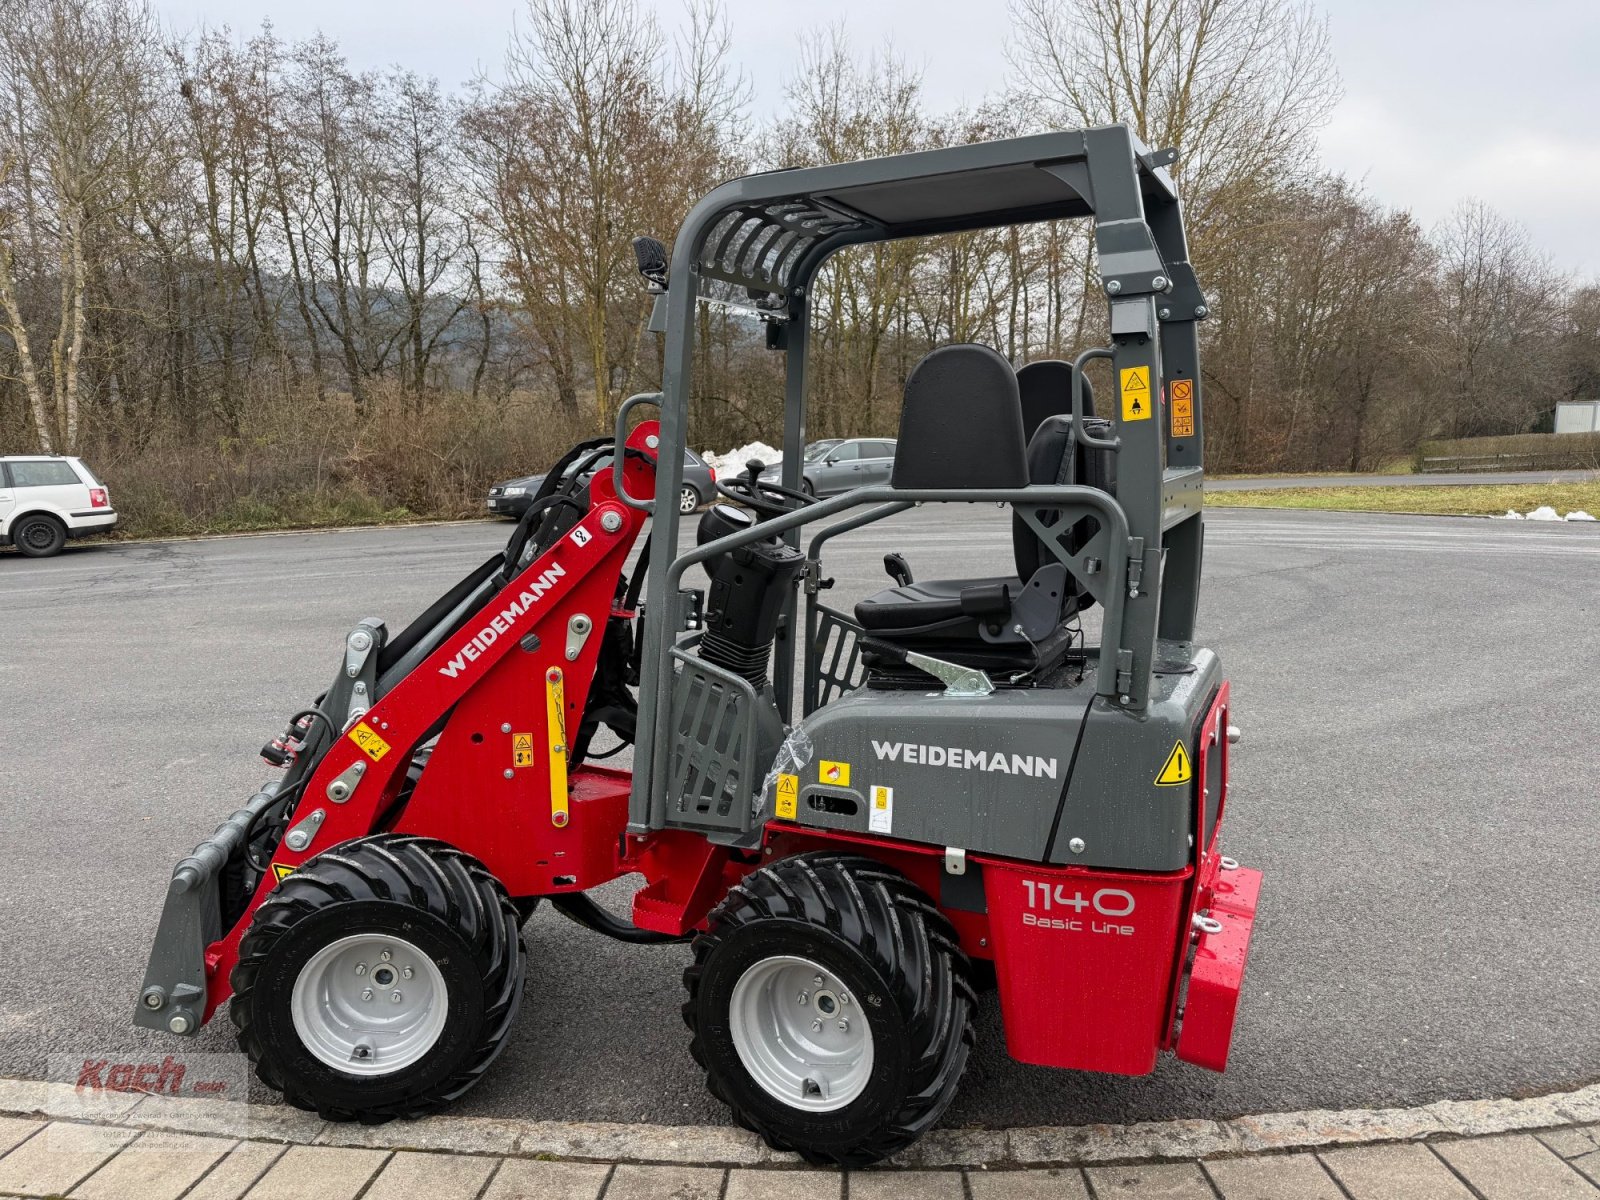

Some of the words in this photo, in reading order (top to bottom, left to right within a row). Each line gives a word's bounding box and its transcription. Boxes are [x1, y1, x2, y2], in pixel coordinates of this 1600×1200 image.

[438, 561, 567, 679] WEIDEMANN
[871, 740, 1057, 779] WEIDEMANN
[1022, 880, 1136, 917] 1140
[1022, 912, 1083, 931] Basic
[1091, 921, 1135, 936] Line
